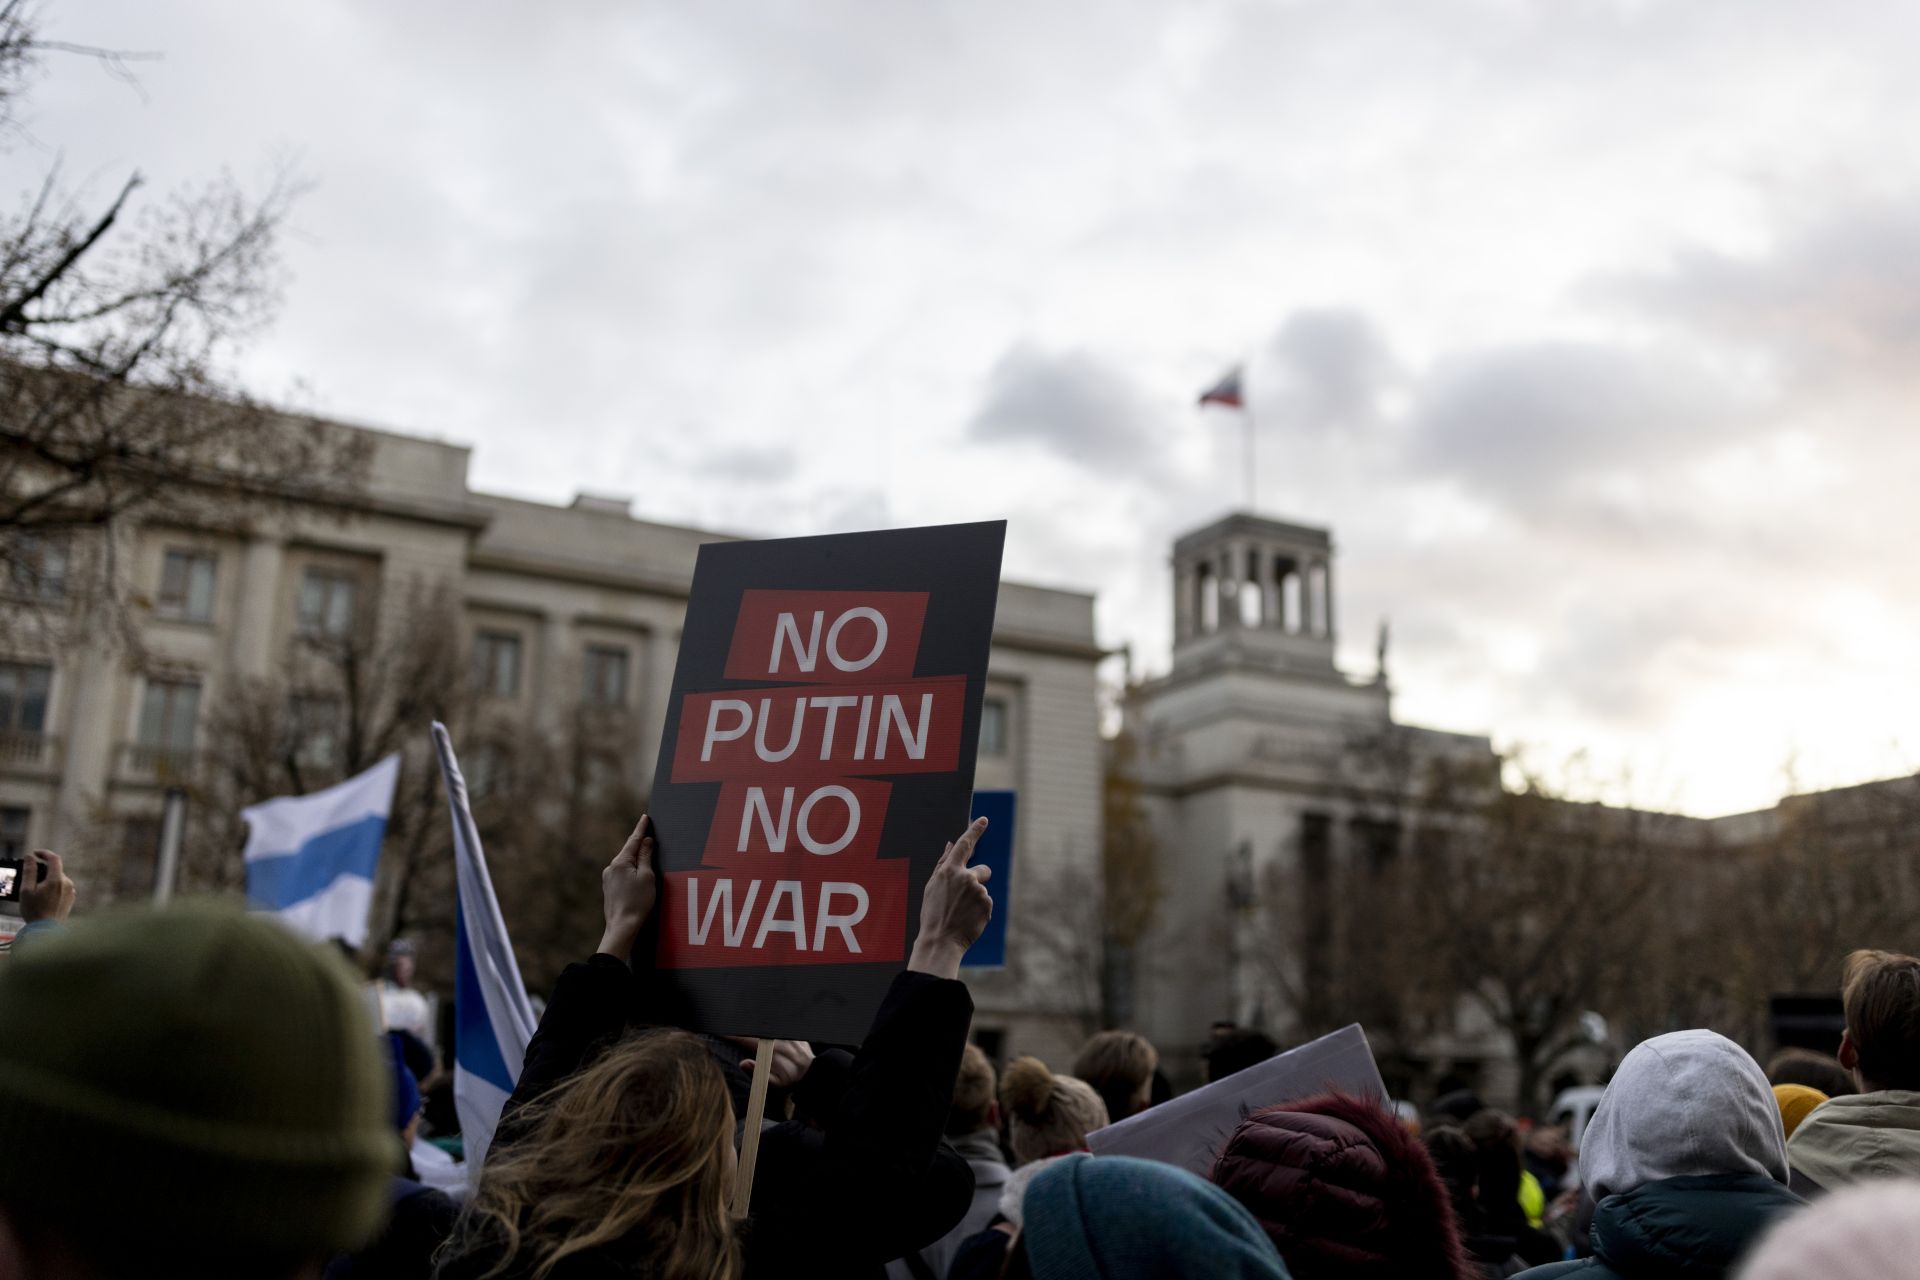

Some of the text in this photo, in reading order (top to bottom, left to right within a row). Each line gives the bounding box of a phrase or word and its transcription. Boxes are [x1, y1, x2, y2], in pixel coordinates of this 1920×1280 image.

[768, 606, 888, 672] NO
[700, 693, 933, 762] PUTIN
[736, 785, 861, 856] NO
[687, 877, 869, 953] WAR
